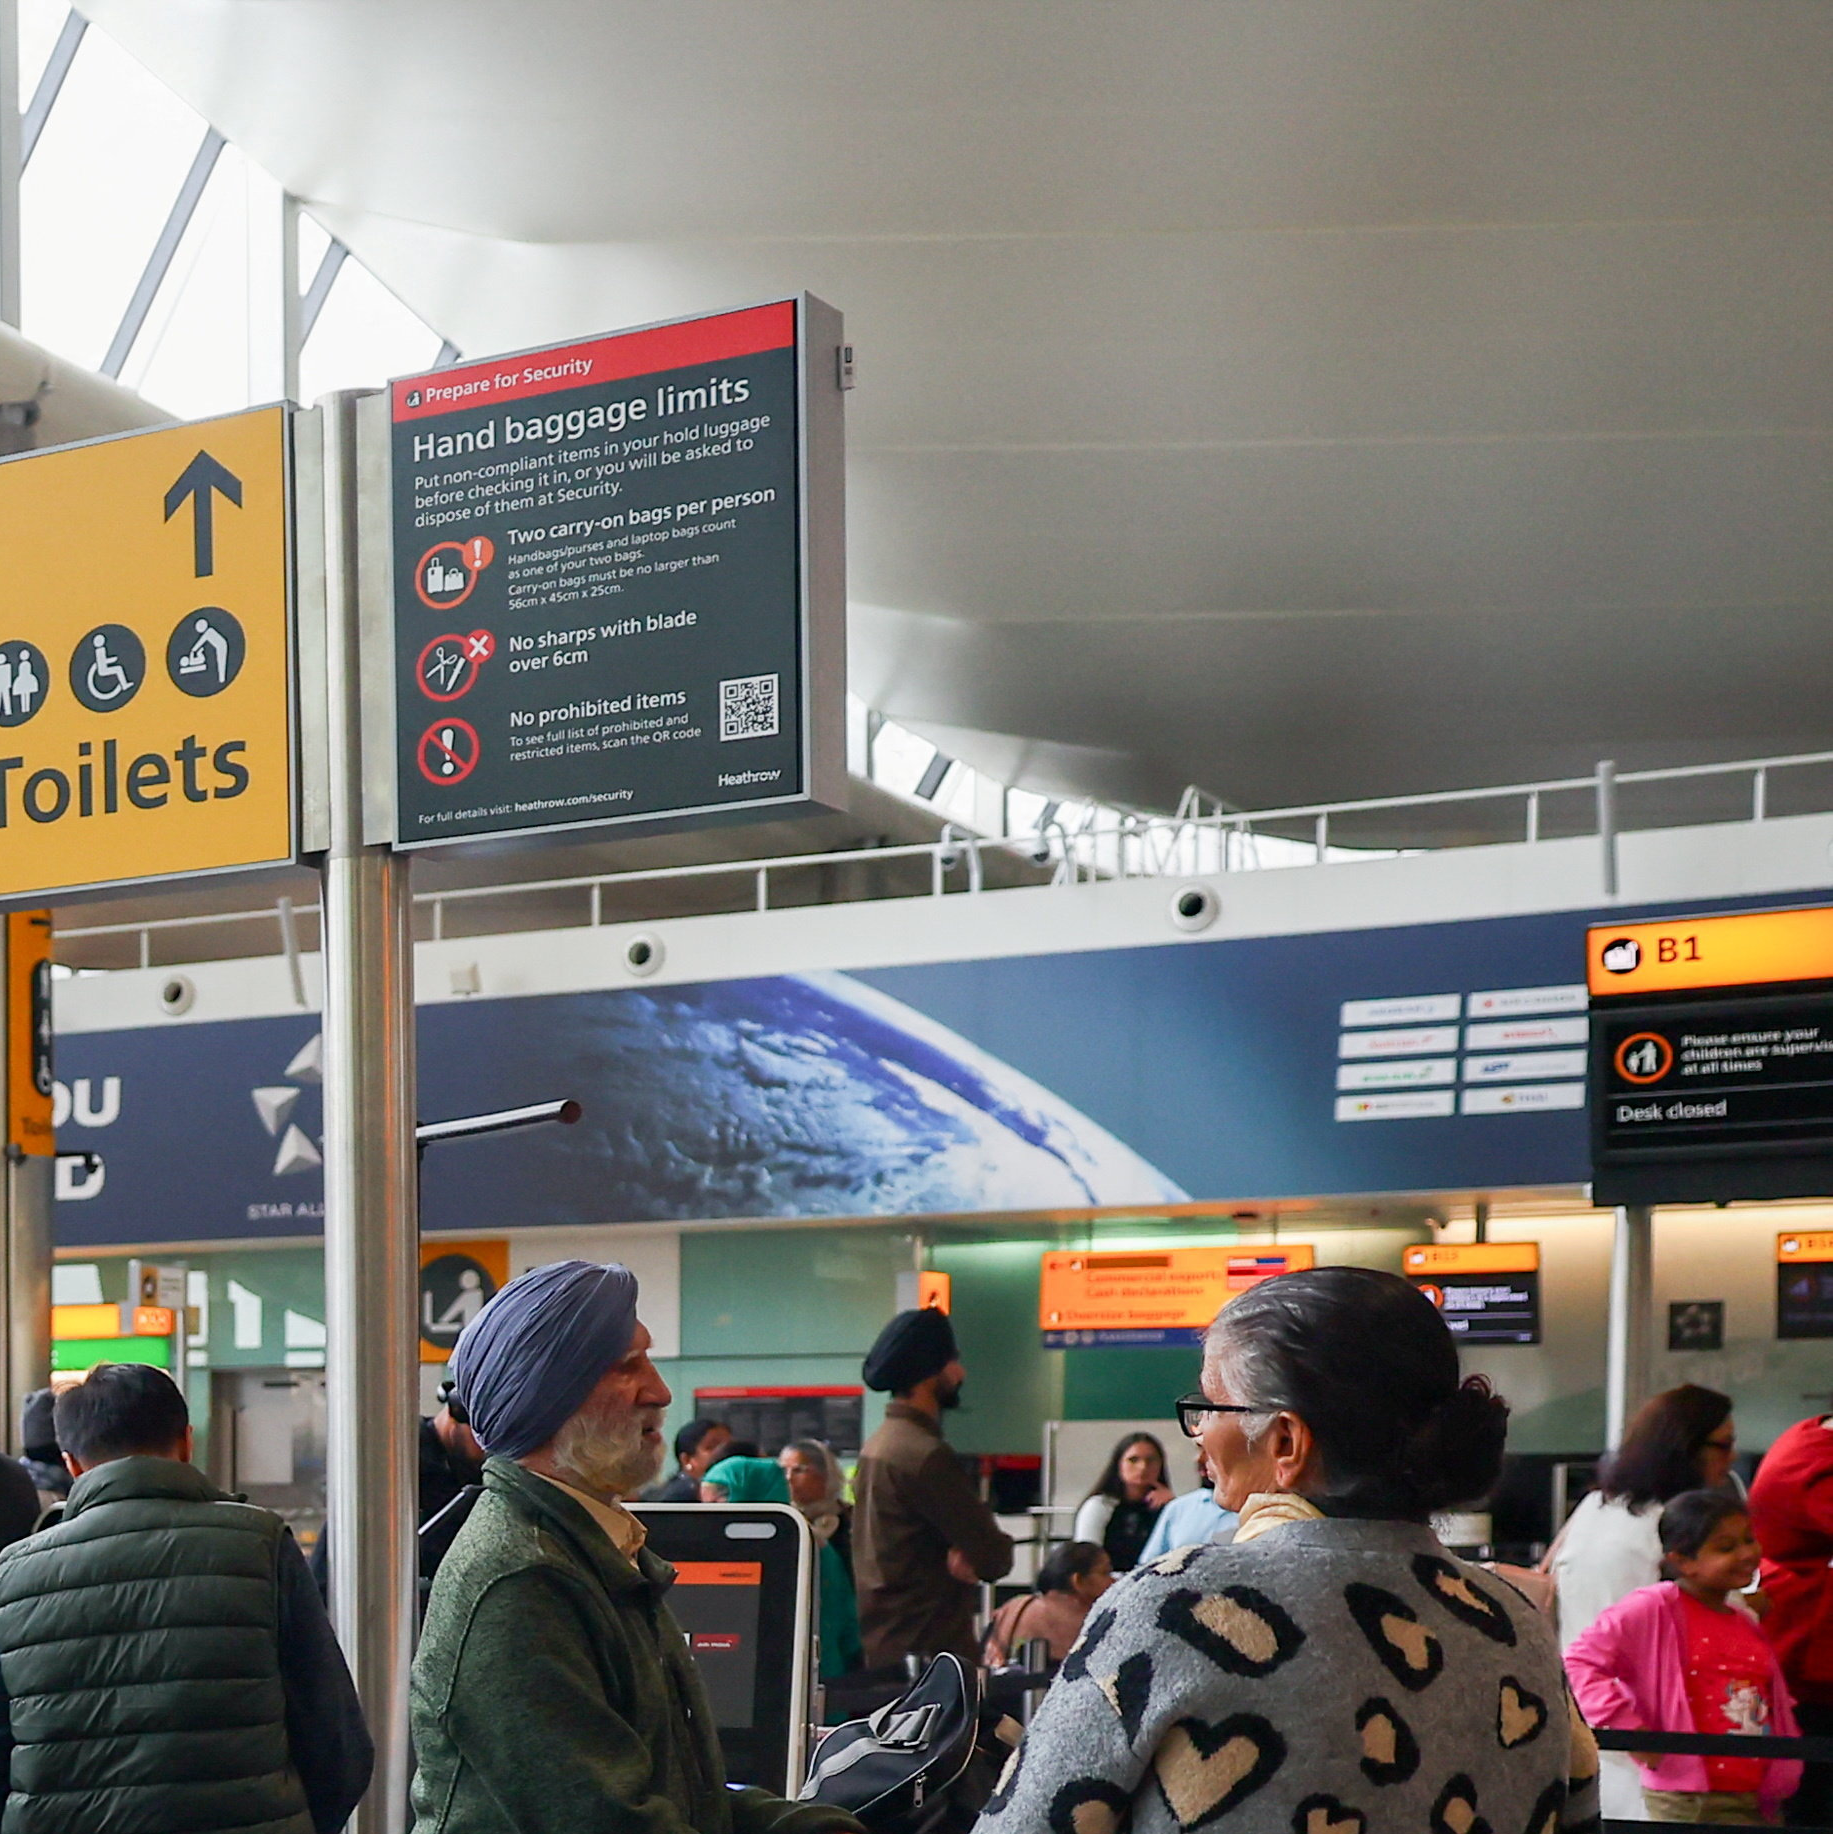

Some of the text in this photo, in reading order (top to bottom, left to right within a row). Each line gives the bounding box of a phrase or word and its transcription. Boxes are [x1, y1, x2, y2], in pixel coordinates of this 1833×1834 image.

[426, 359, 592, 403] Prepare for Security
[413, 377, 749, 462] Hand baggage limits
[414, 415, 770, 490] Put non-compliant items in your hold luggage
[414, 438, 753, 509] before checking it in, or you will be asked to
[414, 480, 622, 528] dispose of them at Security.
[507, 488, 775, 545] Two carry-on bags per person
[507, 518, 736, 565] Handbags/purses and laptop bags count
[507, 549, 645, 580] as one of your two bags.
[507, 553, 719, 596] Carry-on bags must be no larger than
[508, 584, 624, 610] 56cm x 45cm x 25cm.
[509, 610, 697, 652] No sharps with blade
[509, 649, 588, 673] over 6cm
[510, 691, 686, 727] No prohibited items
[509, 712, 688, 747] To see full list of prohibited and
[509, 727, 701, 761] restricted items, scan the QR code
[718, 769, 781, 787] Heathrow
[418, 789, 633, 824] For full details visit: heathrow.com/security
[1658, 936, 1702, 963] B1
[1731, 1031, 1781, 1044] ensure
[1783, 1027, 1820, 1043] your
[1681, 1046, 1742, 1061] children
[1721, 1059, 1764, 1073] times
[1617, 1099, 1728, 1122] Desk closed
